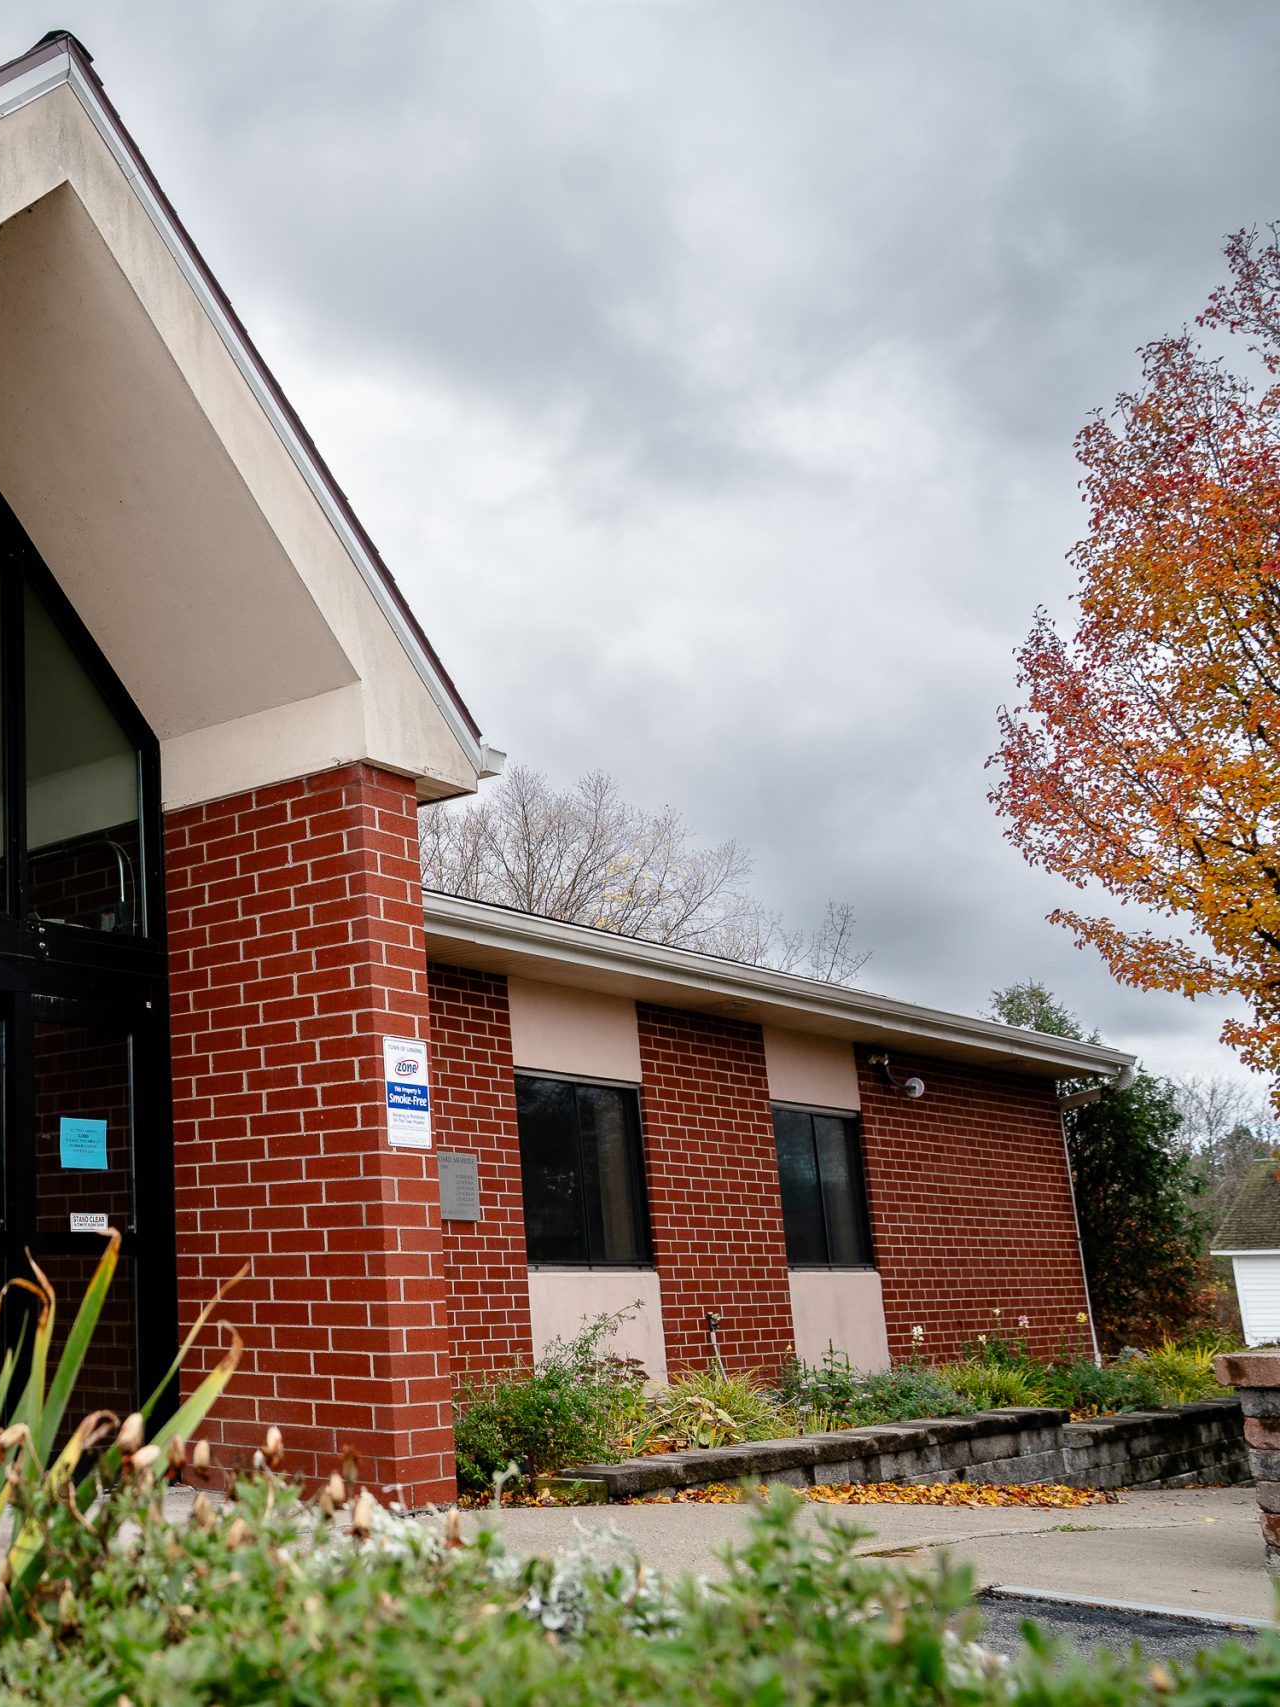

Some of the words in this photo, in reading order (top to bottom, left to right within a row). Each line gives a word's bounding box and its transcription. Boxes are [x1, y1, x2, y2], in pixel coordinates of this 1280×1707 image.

[397, 1062, 417, 1073] zone
[402, 1086, 418, 1095] Property
[389, 1093, 428, 1107] Smoke-Free
[73, 1215, 89, 1223] STAND
